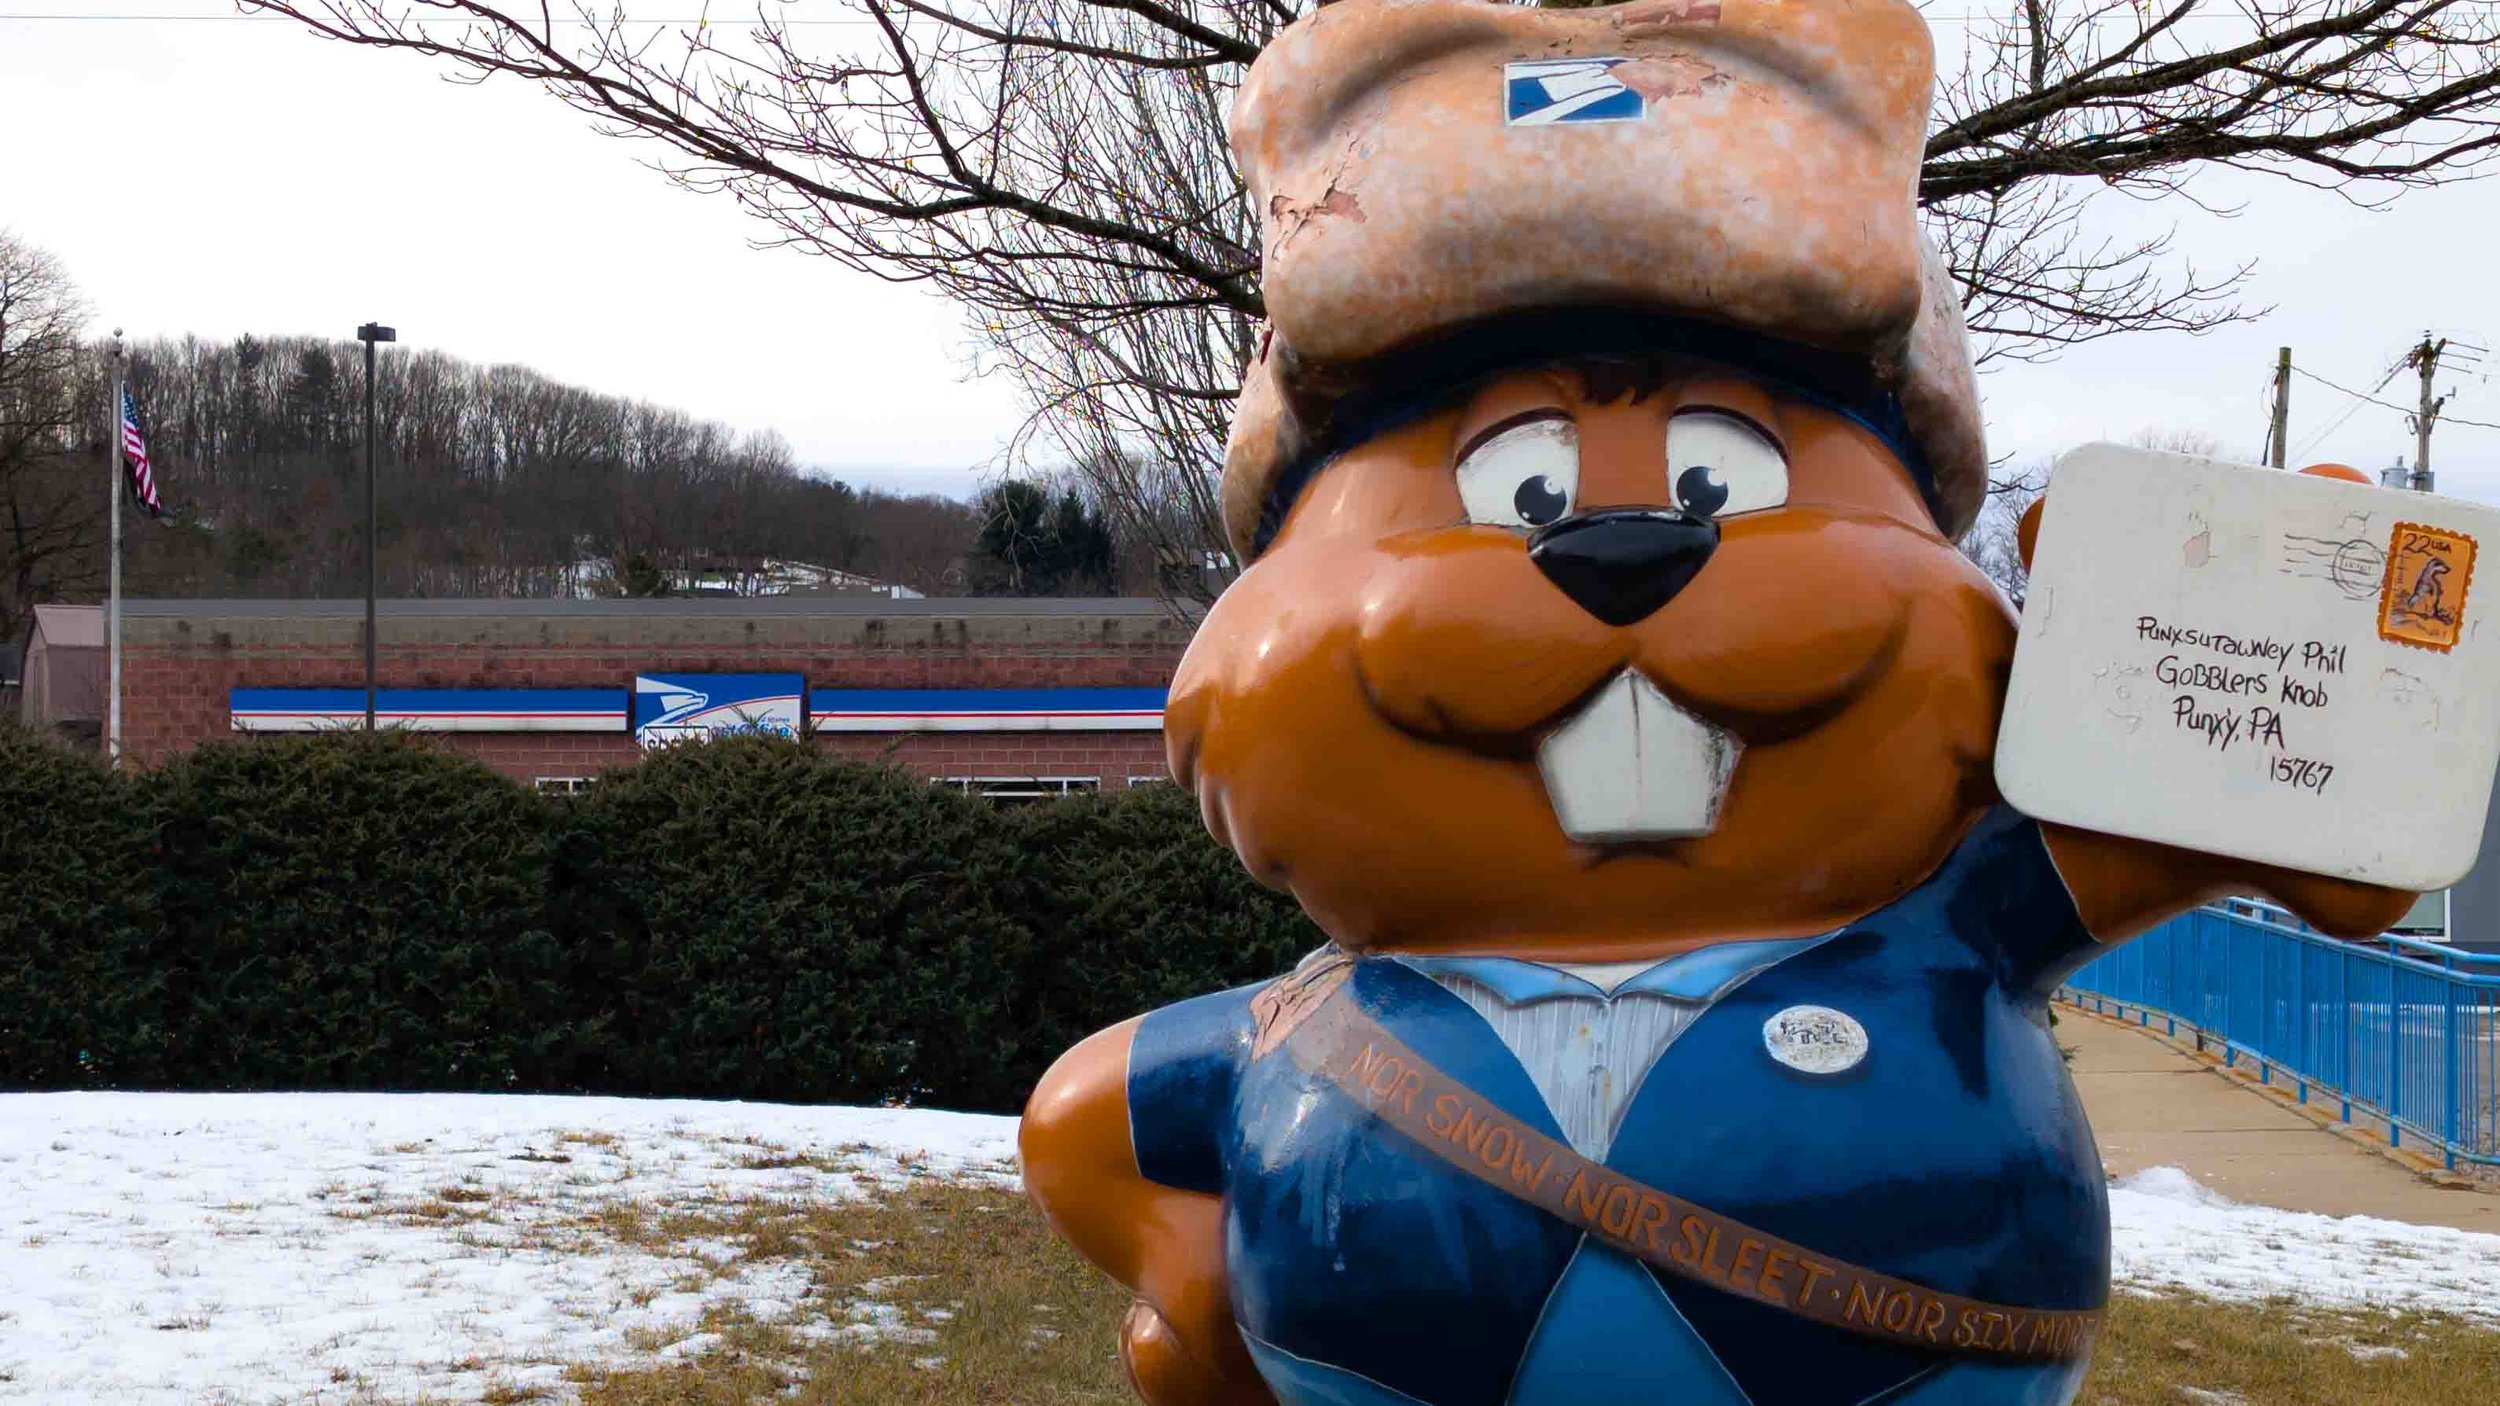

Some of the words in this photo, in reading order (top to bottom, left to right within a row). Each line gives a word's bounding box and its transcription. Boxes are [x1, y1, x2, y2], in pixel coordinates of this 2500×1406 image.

[2403, 532, 2433, 556] 22
[2431, 540, 2452, 553] USA
[2302, 641, 2346, 673] Phil
[2248, 706, 2285, 749] PA
[2270, 756, 2334, 795] 15767
[1350, 1044, 1424, 1115] NOR
[1425, 1094, 1553, 1192] SNOW
[1563, 1168, 1668, 1248] NOR
[1669, 1214, 1835, 1303] SLEET
[1844, 1280, 1946, 1343] NOR
[1952, 1307, 2026, 1352] SIX
